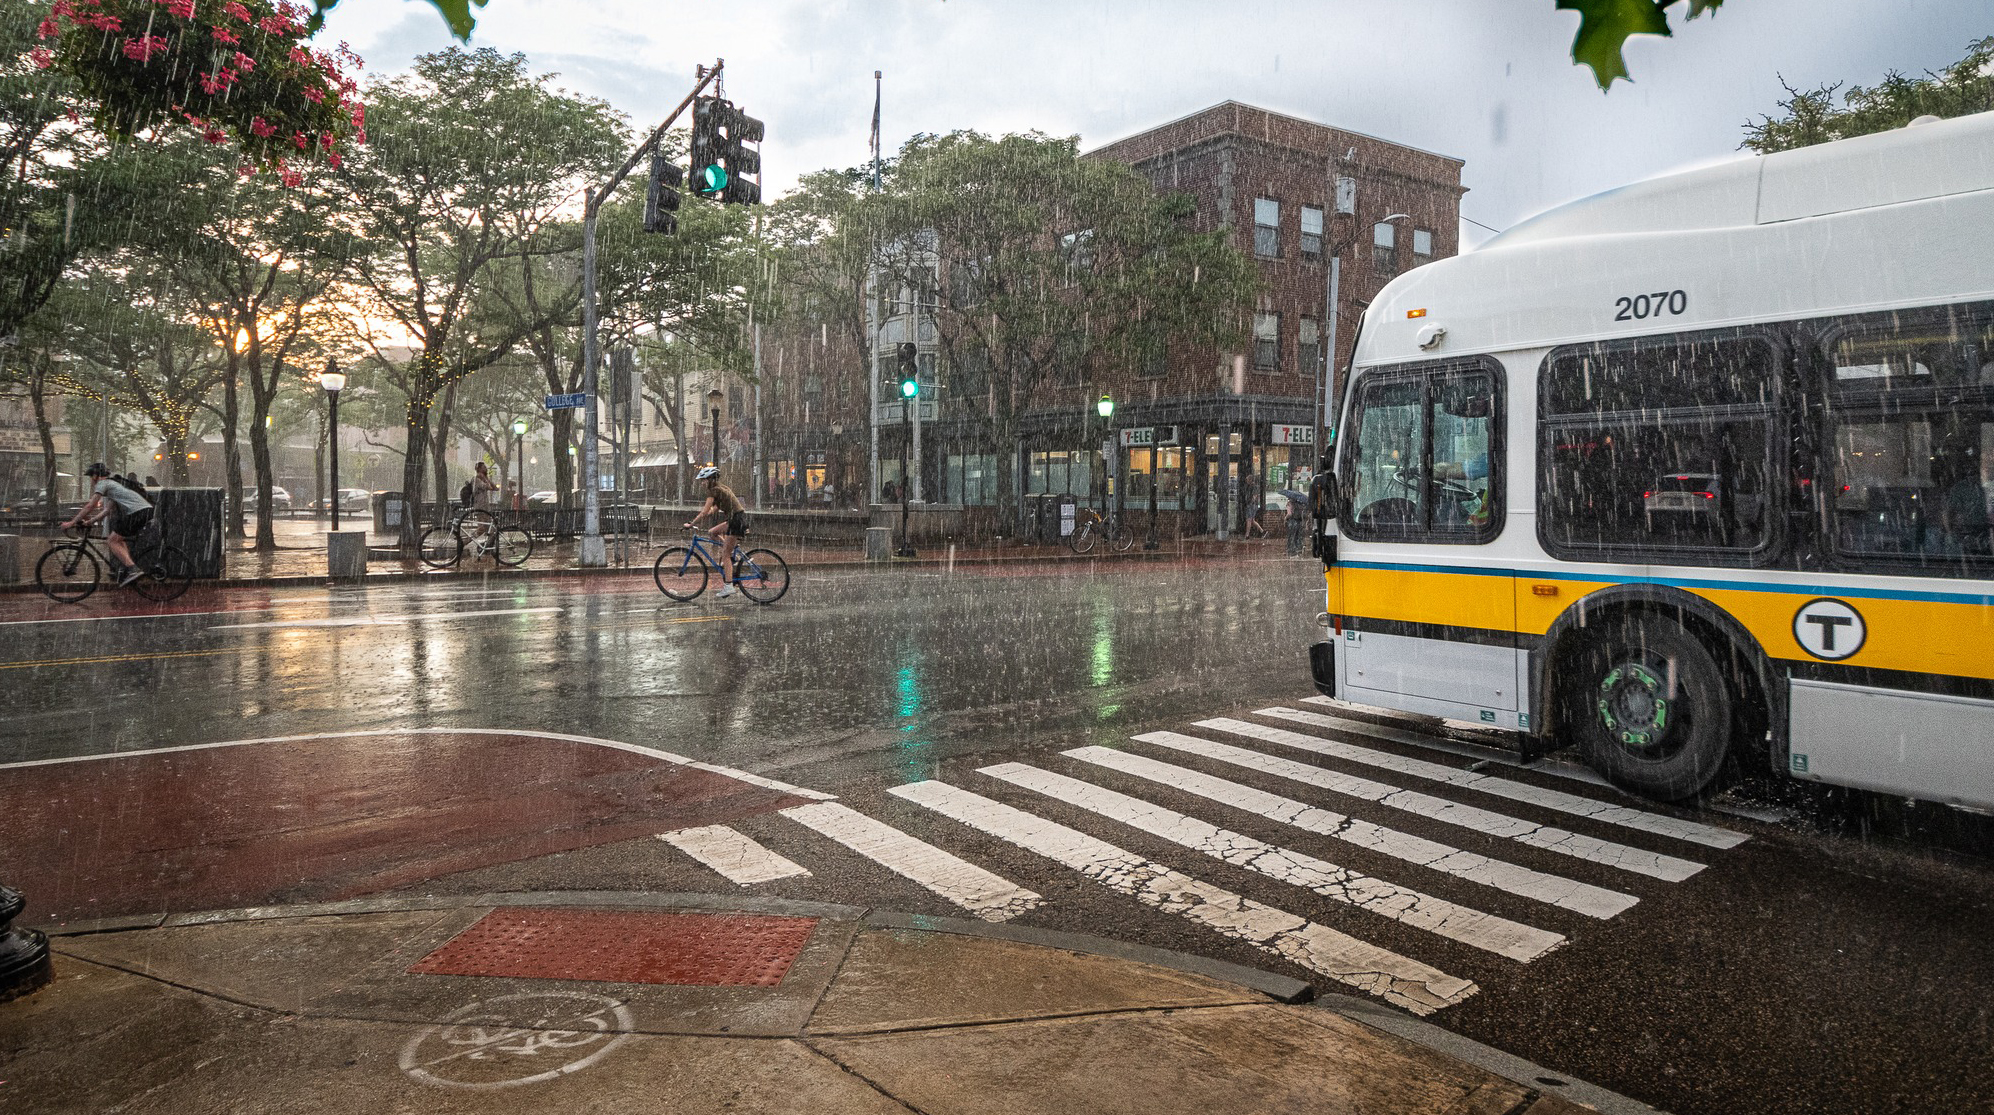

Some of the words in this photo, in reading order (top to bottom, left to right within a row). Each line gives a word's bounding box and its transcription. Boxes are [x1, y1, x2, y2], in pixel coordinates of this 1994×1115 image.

[1614, 289, 1687, 321] 2070
[547, 395, 574, 407] COLLEGE
[1124, 430, 1153, 444] 7-ELE
[1806, 614, 1852, 651] T
